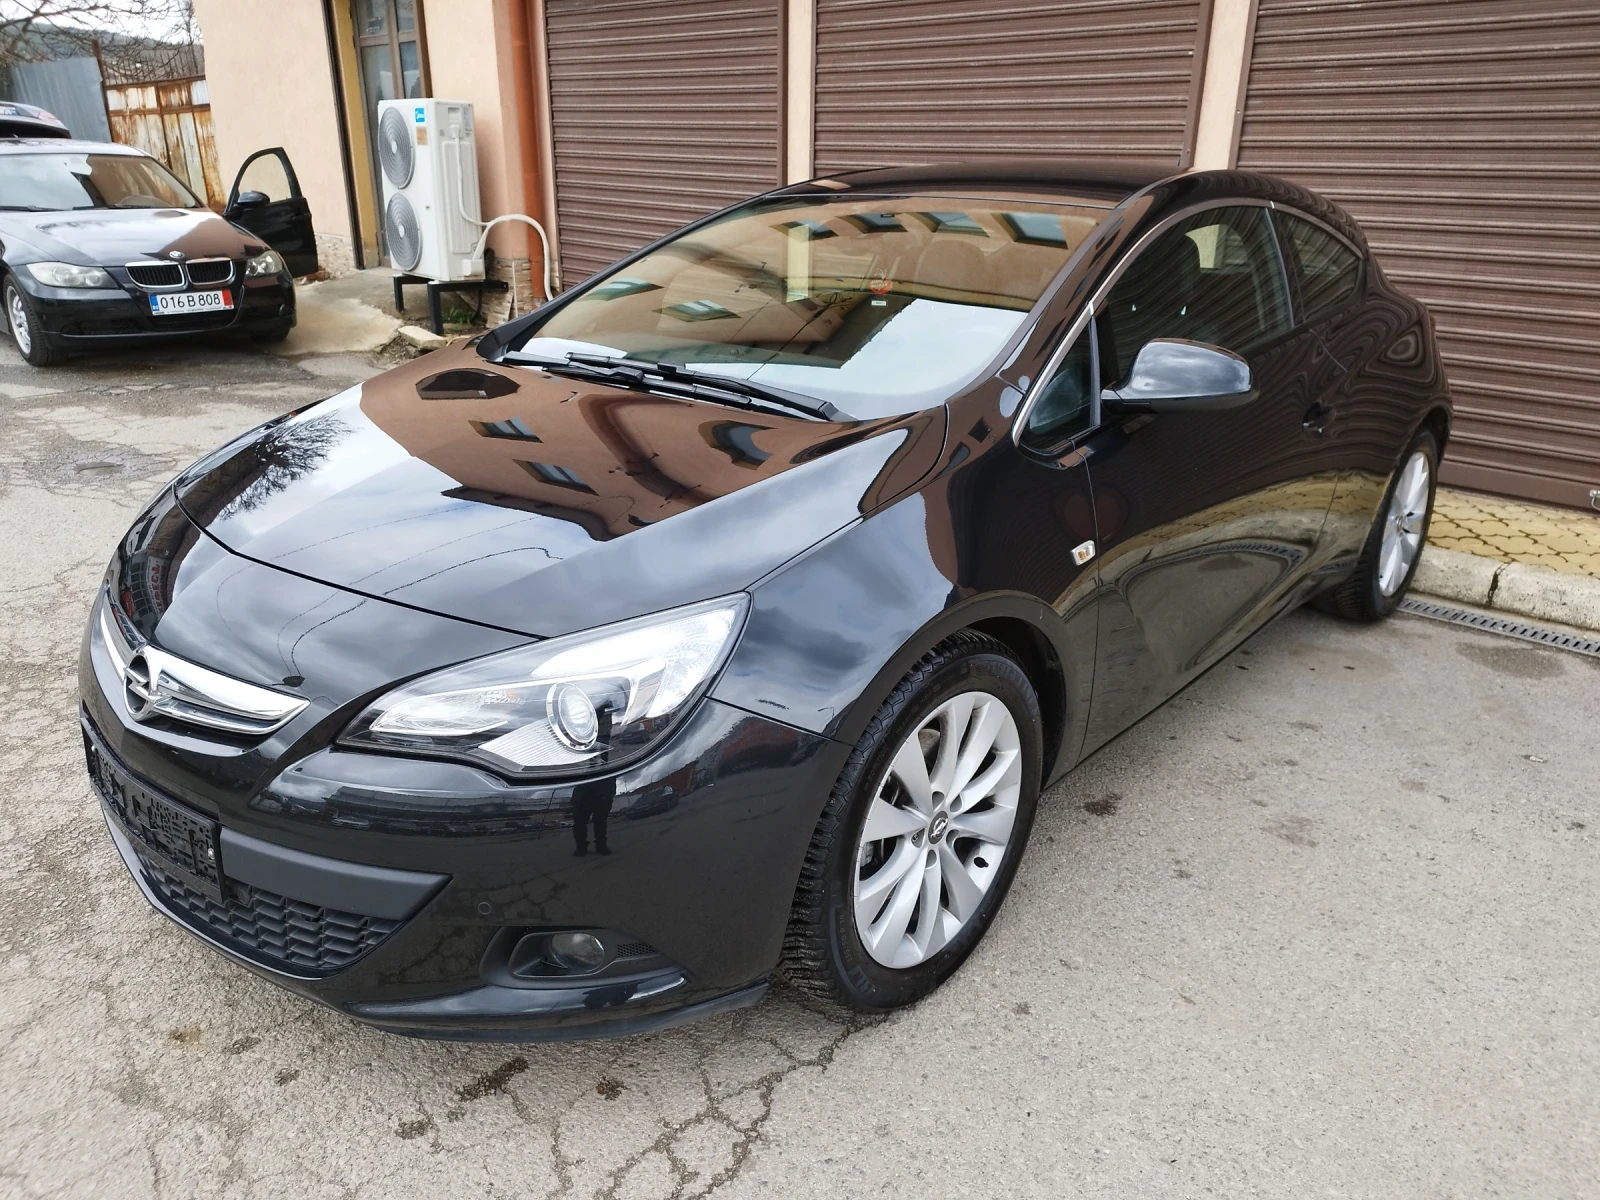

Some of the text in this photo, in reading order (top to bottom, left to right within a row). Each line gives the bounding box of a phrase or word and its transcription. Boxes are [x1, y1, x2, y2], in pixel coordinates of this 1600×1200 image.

[160, 293, 221, 309] 016 B 808
